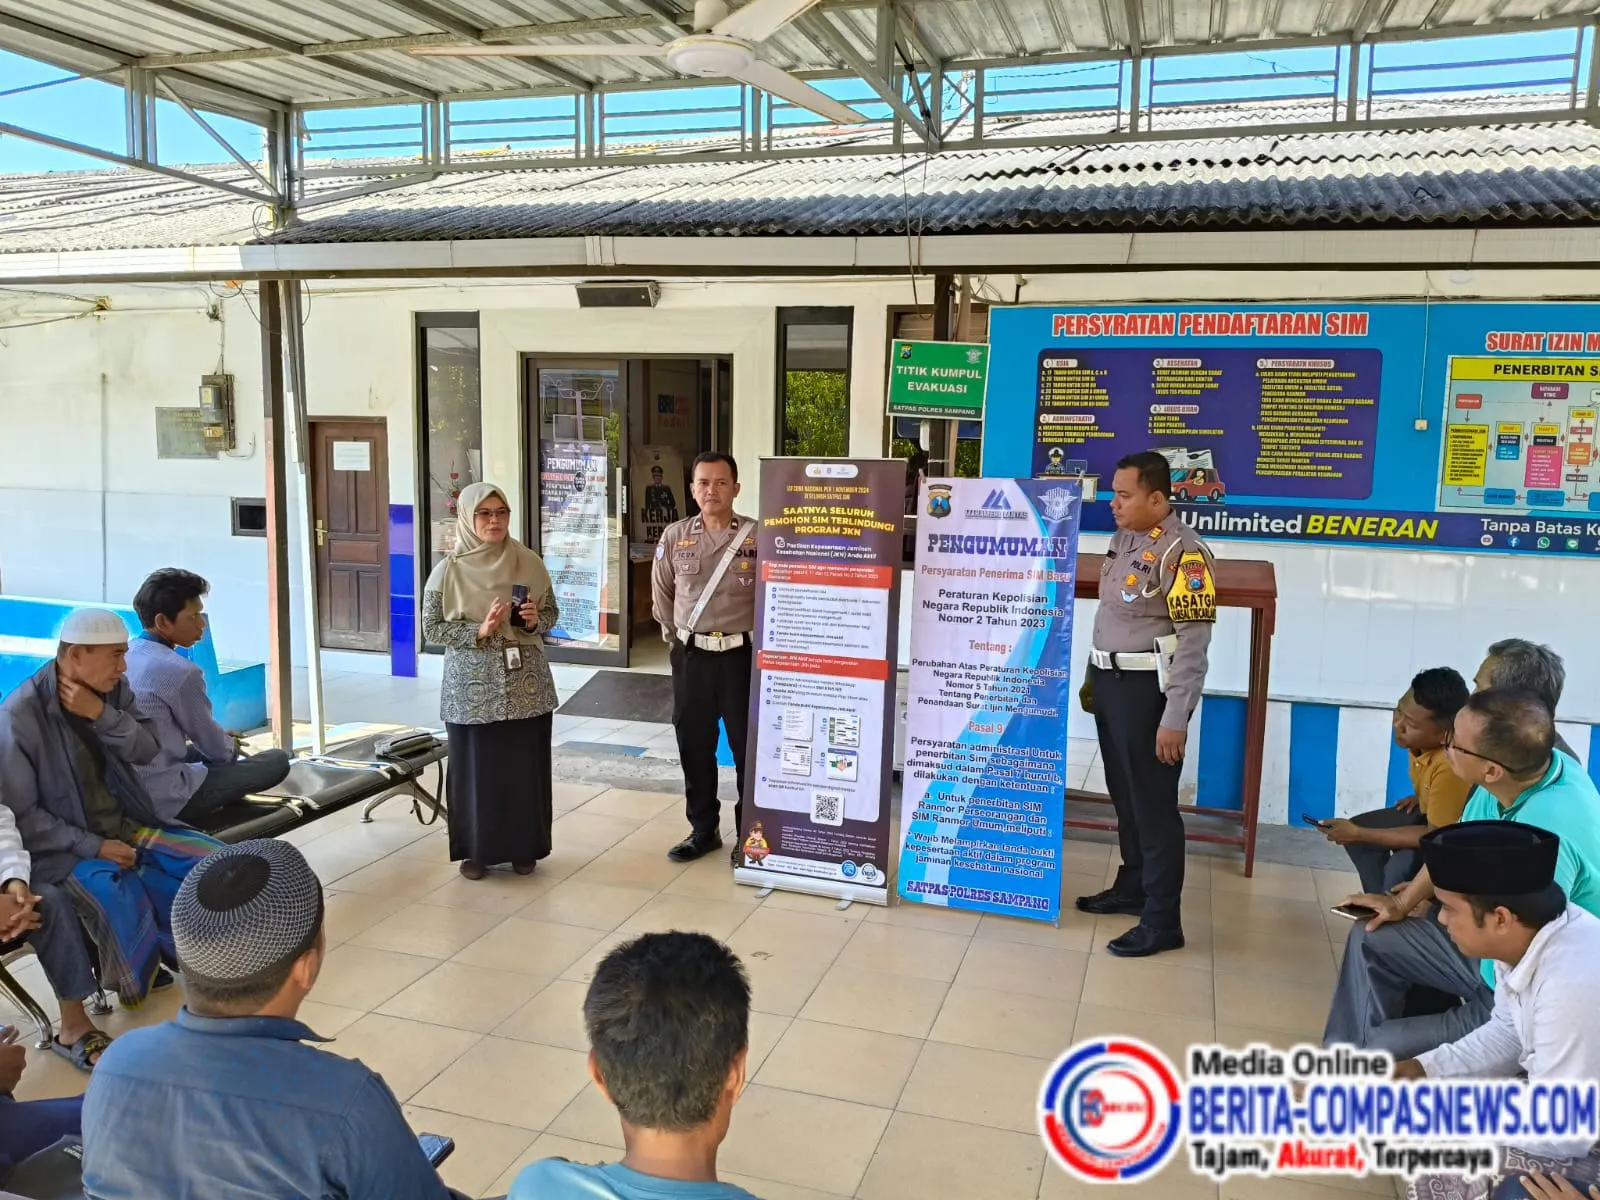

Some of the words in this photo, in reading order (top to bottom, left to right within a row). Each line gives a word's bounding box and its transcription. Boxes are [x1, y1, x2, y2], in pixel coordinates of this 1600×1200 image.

[1052, 314, 1176, 336] PERSYRATAN
[1179, 313, 1321, 336] PENDAFTARAN
[1326, 312, 1369, 335] SIM
[1486, 332, 1544, 352] SURAT
[1548, 332, 1584, 351] IZIN
[897, 366, 927, 375] TITIK
[932, 368, 982, 379] KUMPUL
[1494, 364, 1584, 376] PENERBITAN
[1590, 365, 1600, 376] S
[908, 382, 967, 393] EVAKUASI
[641, 509, 680, 523] KERJA
[784, 507, 827, 515] SAATNYA
[830, 506, 874, 518] SELURUH
[764, 517, 809, 527] PEMOHON
[811, 516, 829, 524] SIM
[832, 516, 895, 532] TERLINDUNGI
[794, 526, 840, 535] PROGRAM
[841, 527, 861, 536] JKN
[1179, 512, 1302, 533] Unlimited
[1306, 515, 1438, 539] BENERAN
[1480, 518, 1530, 535] Tanpa
[1535, 521, 1581, 535] Batas
[927, 534, 1067, 558] PENGUMUMAN
[921, 565, 977, 578] Persyaratan
[979, 569, 1024, 580] Penerima
[1027, 571, 1044, 580] SIM
[1130, 561, 1151, 575] POLRI
[939, 589, 990, 600] Peraturan
[992, 591, 1048, 604] Kepolisian
[922, 600, 959, 612] Negara
[962, 603, 1009, 615] Republik
[1011, 605, 1064, 617] Indonesia
[939, 615, 974, 624] Nomor
[986, 617, 1018, 626] Tahun
[1020, 618, 1046, 628] 2023
[969, 640, 1006, 654] Tentang
[912, 658, 957, 669] Perubahan
[959, 662, 977, 671] Atas
[980, 664, 1021, 675] Peraturan
[1023, 667, 1068, 678] Kepolisian
[933, 670, 963, 680] Negara
[965, 672, 1001, 683] Republik
[1003, 675, 1045, 686] Indonesia
[946, 681, 974, 690] Nomor
[976, 682, 981, 690] 5
[983, 683, 1009, 692] Tahun
[918, 697, 964, 708] Penandaan
[990, 704, 1003, 713] Ijin
[939, 689, 972, 701] Tentang
[974, 692, 1019, 705] Penerbitan
[1021, 696, 1037, 705] dan
[969, 721, 995, 733] Pasal
[997, 724, 1004, 733] 9
[911, 737, 968, 752] Persyaratan
[970, 743, 1030, 756] administrasi
[1032, 749, 1062, 760] Untuk
[916, 749, 967, 763] penerbitan
[991, 756, 1055, 770] sebagaimana
[907, 759, 953, 771] dimaksud
[955, 763, 984, 774] dalam
[987, 767, 1014, 777] Pasal
[1024, 771, 1051, 781] huruf
[913, 770, 960, 783] dilakukan
[962, 775, 997, 789] dengan
[1000, 780, 1048, 792] ketentuan
[938, 792, 966, 804] Untuk
[969, 796, 1021, 810] penerbitan
[1023, 801, 1042, 812] SIM
[912, 812, 930, 821] SIM
[932, 814, 969, 826] Ranmor
[918, 801, 955, 812] Ranmor
[958, 805, 1026, 822] Perseorangan
[1028, 815, 1047, 824] dan
[914, 833, 939, 843] Wajib
[941, 836, 1000, 851] Melampirkan
[1002, 843, 1029, 854] tanda
[1031, 848, 1055, 858] bukti
[905, 842, 960, 857] kepesertaan
[963, 850, 983, 860] aktif
[985, 852, 1014, 863] dalam
[1015, 857, 1056, 869] program
[916, 854, 952, 867] jaminan
[954, 859, 1002, 872] kesehatan
[1004, 866, 1044, 878] nasional
[949, 885, 992, 902] POLRES
[993, 891, 1050, 911] SAMPANG
